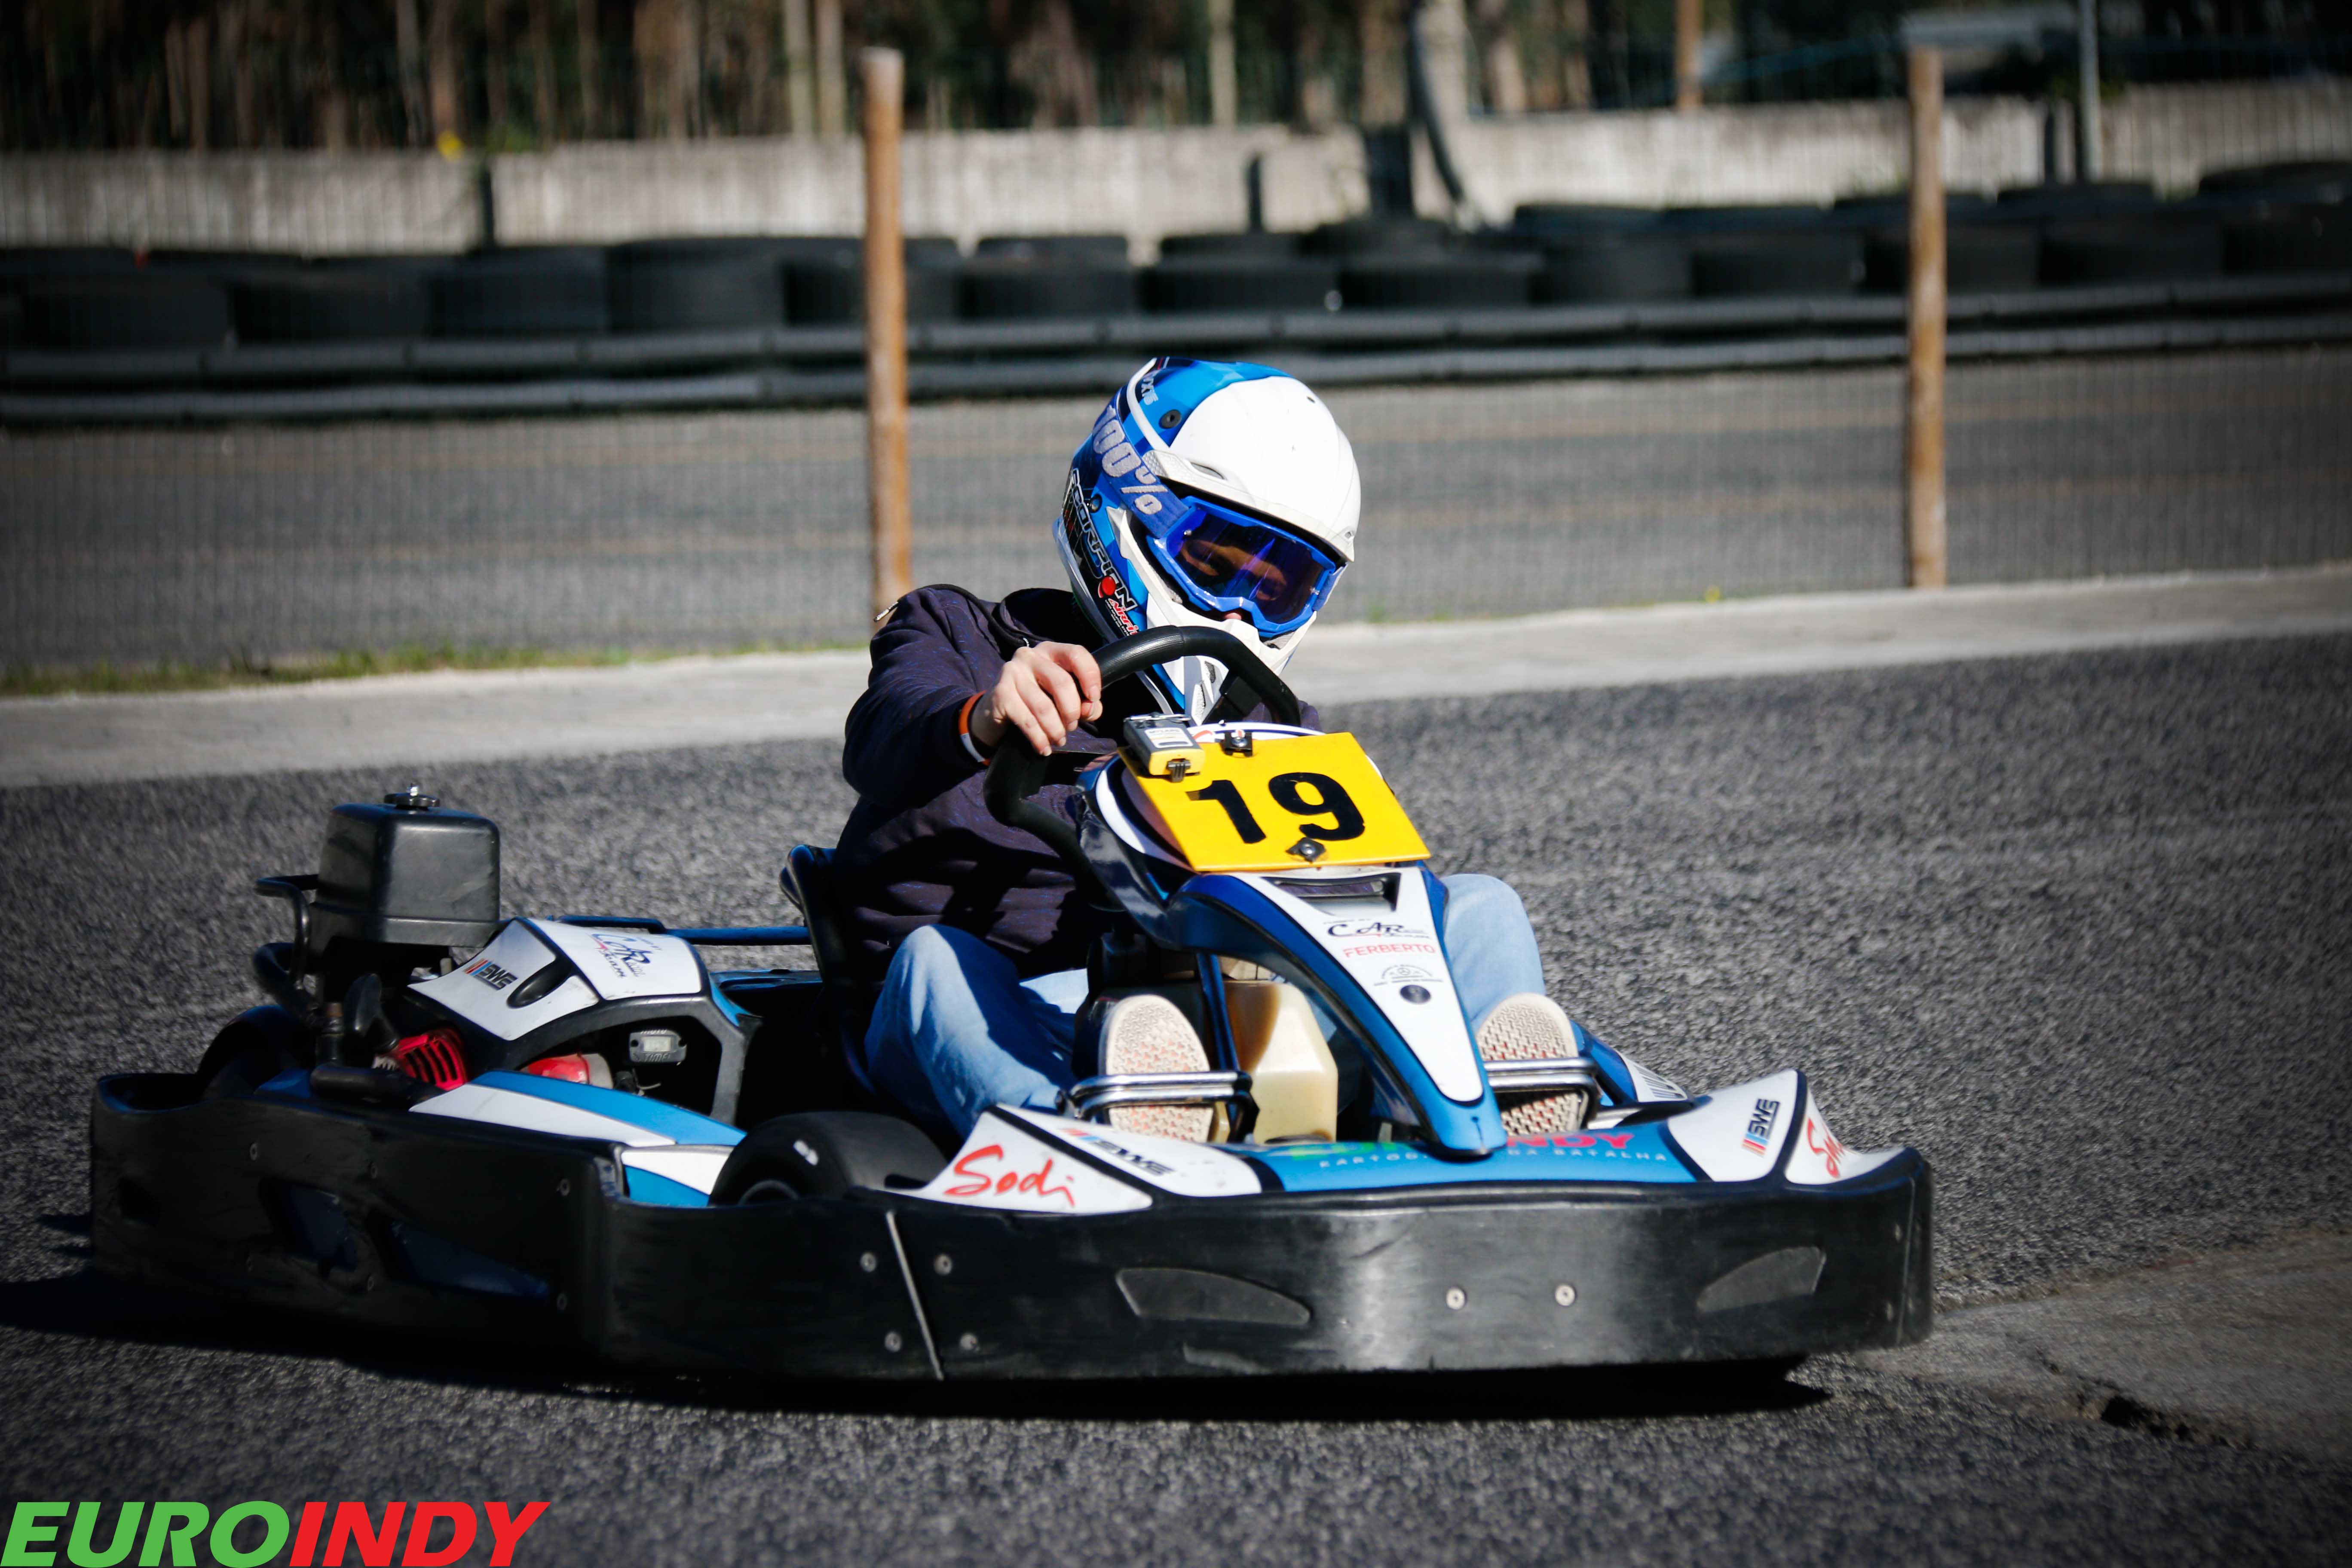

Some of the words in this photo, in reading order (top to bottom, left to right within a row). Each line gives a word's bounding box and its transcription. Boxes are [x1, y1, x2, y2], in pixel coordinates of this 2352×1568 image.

[1093, 404, 1168, 515] 100%
[1066, 468, 1138, 611] SCORPION
[1186, 772, 1365, 844] 19
[1342, 943, 1436, 958] FERBERTO
[944, 1144, 1075, 1207] Sodi
